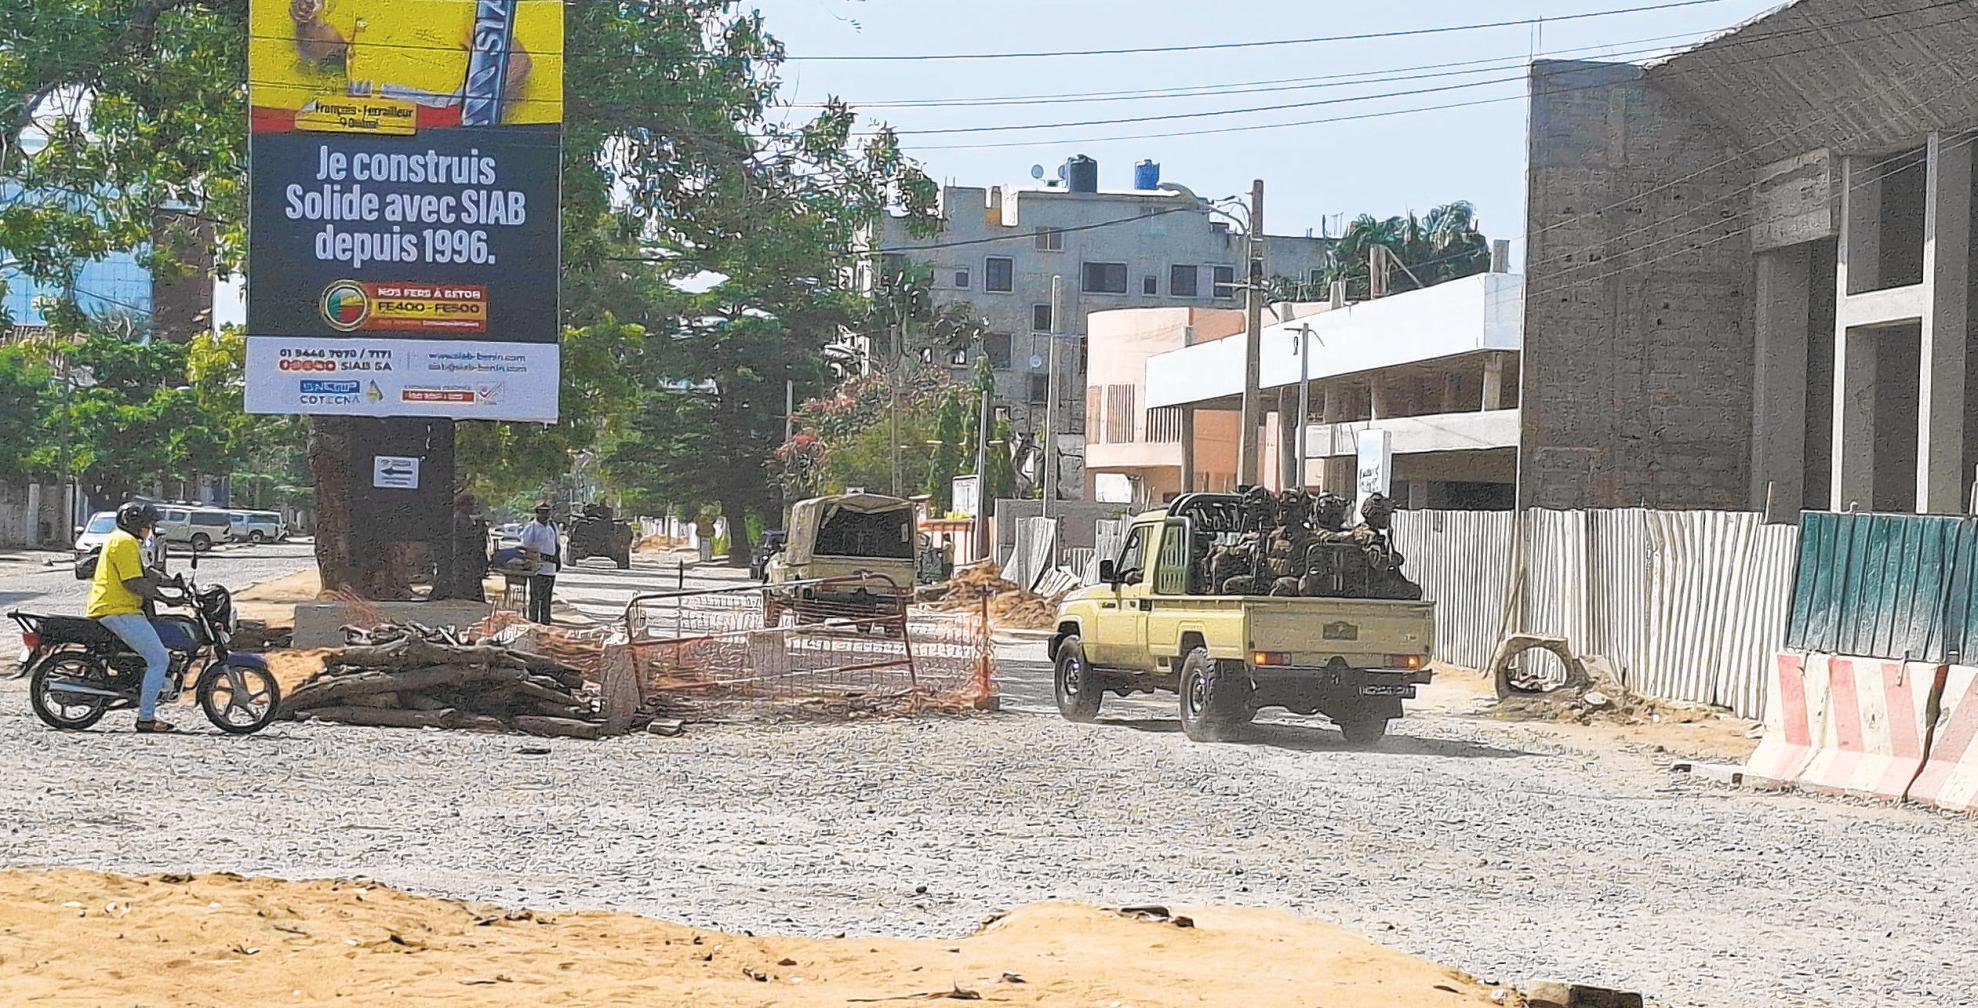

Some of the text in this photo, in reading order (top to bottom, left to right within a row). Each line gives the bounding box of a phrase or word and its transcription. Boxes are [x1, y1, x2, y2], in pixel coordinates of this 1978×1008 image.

[316, 145, 496, 185] Je construis
[286, 184, 526, 225] Solide avec SIAB
[315, 224, 496, 268] depuis 1996.
[378, 288, 400, 297] NOS
[378, 301, 425, 313] FE400
[435, 303, 480, 314] FE500
[280, 349, 291, 357] 01
[329, 349, 357, 359] 7070
[368, 350, 391, 359] 7171
[341, 362, 392, 371] SIAB SA
[300, 395, 360, 404] COTECNA
